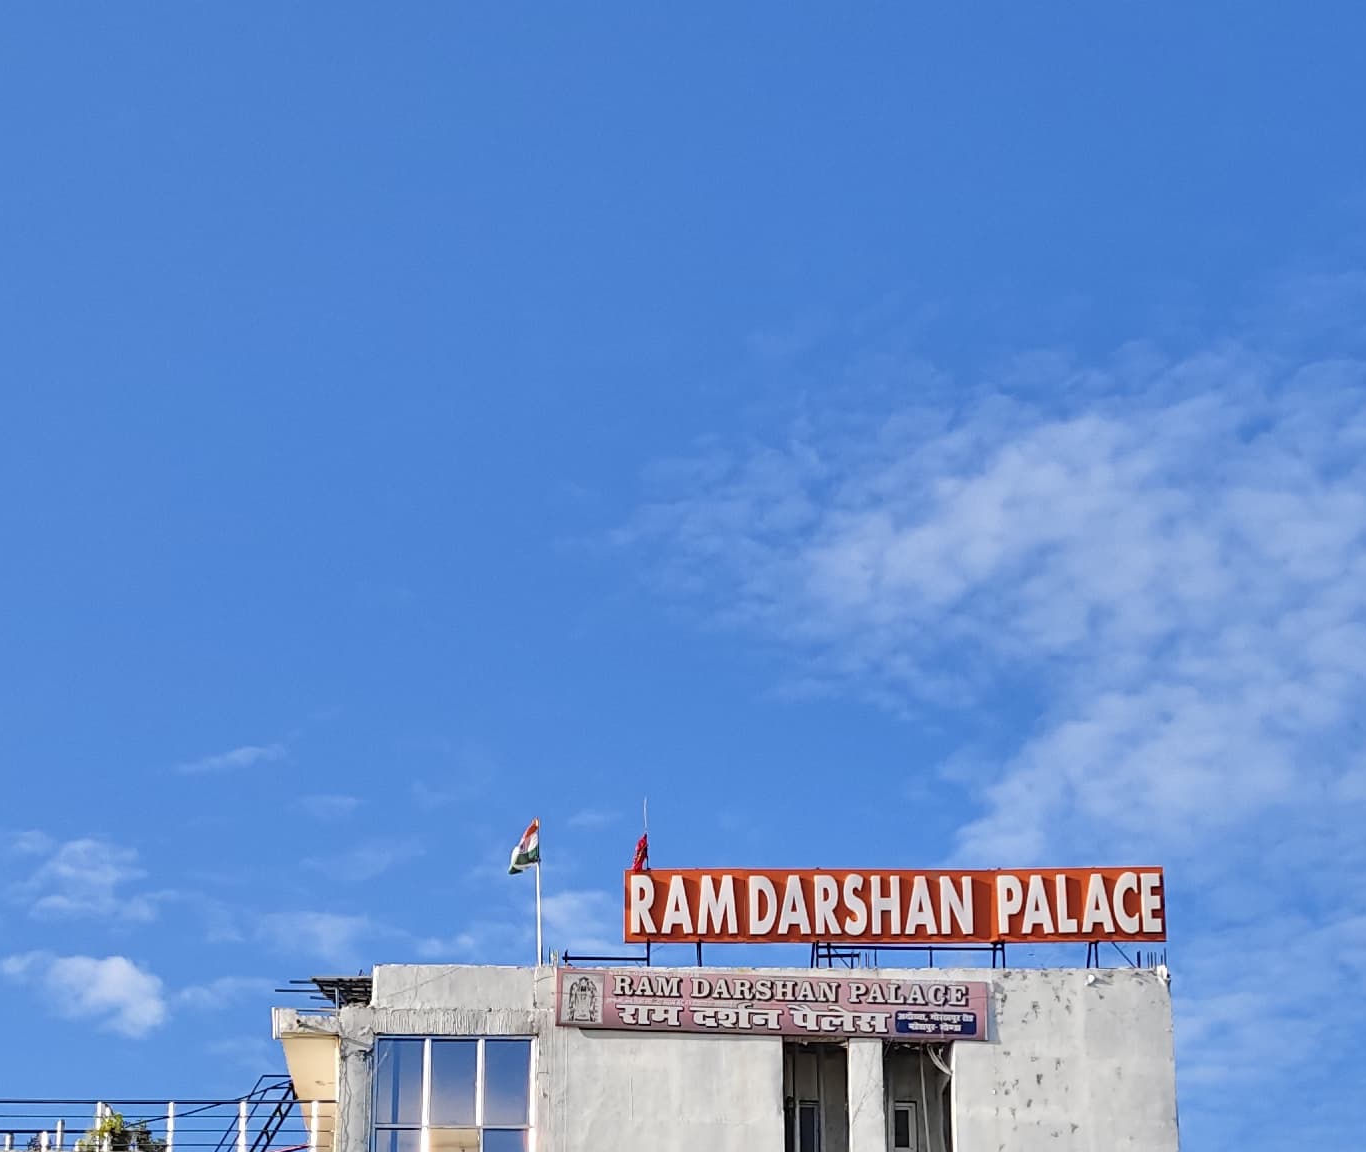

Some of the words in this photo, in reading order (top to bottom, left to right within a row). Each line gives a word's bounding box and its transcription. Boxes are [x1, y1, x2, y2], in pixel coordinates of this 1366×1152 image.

[630, 874, 739, 935] RAM
[748, 873, 974, 936] DARSHAN
[996, 871, 1164, 934] PALACE
[613, 975, 683, 997] RAM
[690, 978, 840, 1003] DARSHAN
[849, 982, 969, 1006] PALACE
[616, 1004, 683, 1026] राम
[689, 1002, 783, 1030] दर्शन
[787, 1004, 892, 1034] पैलेस
